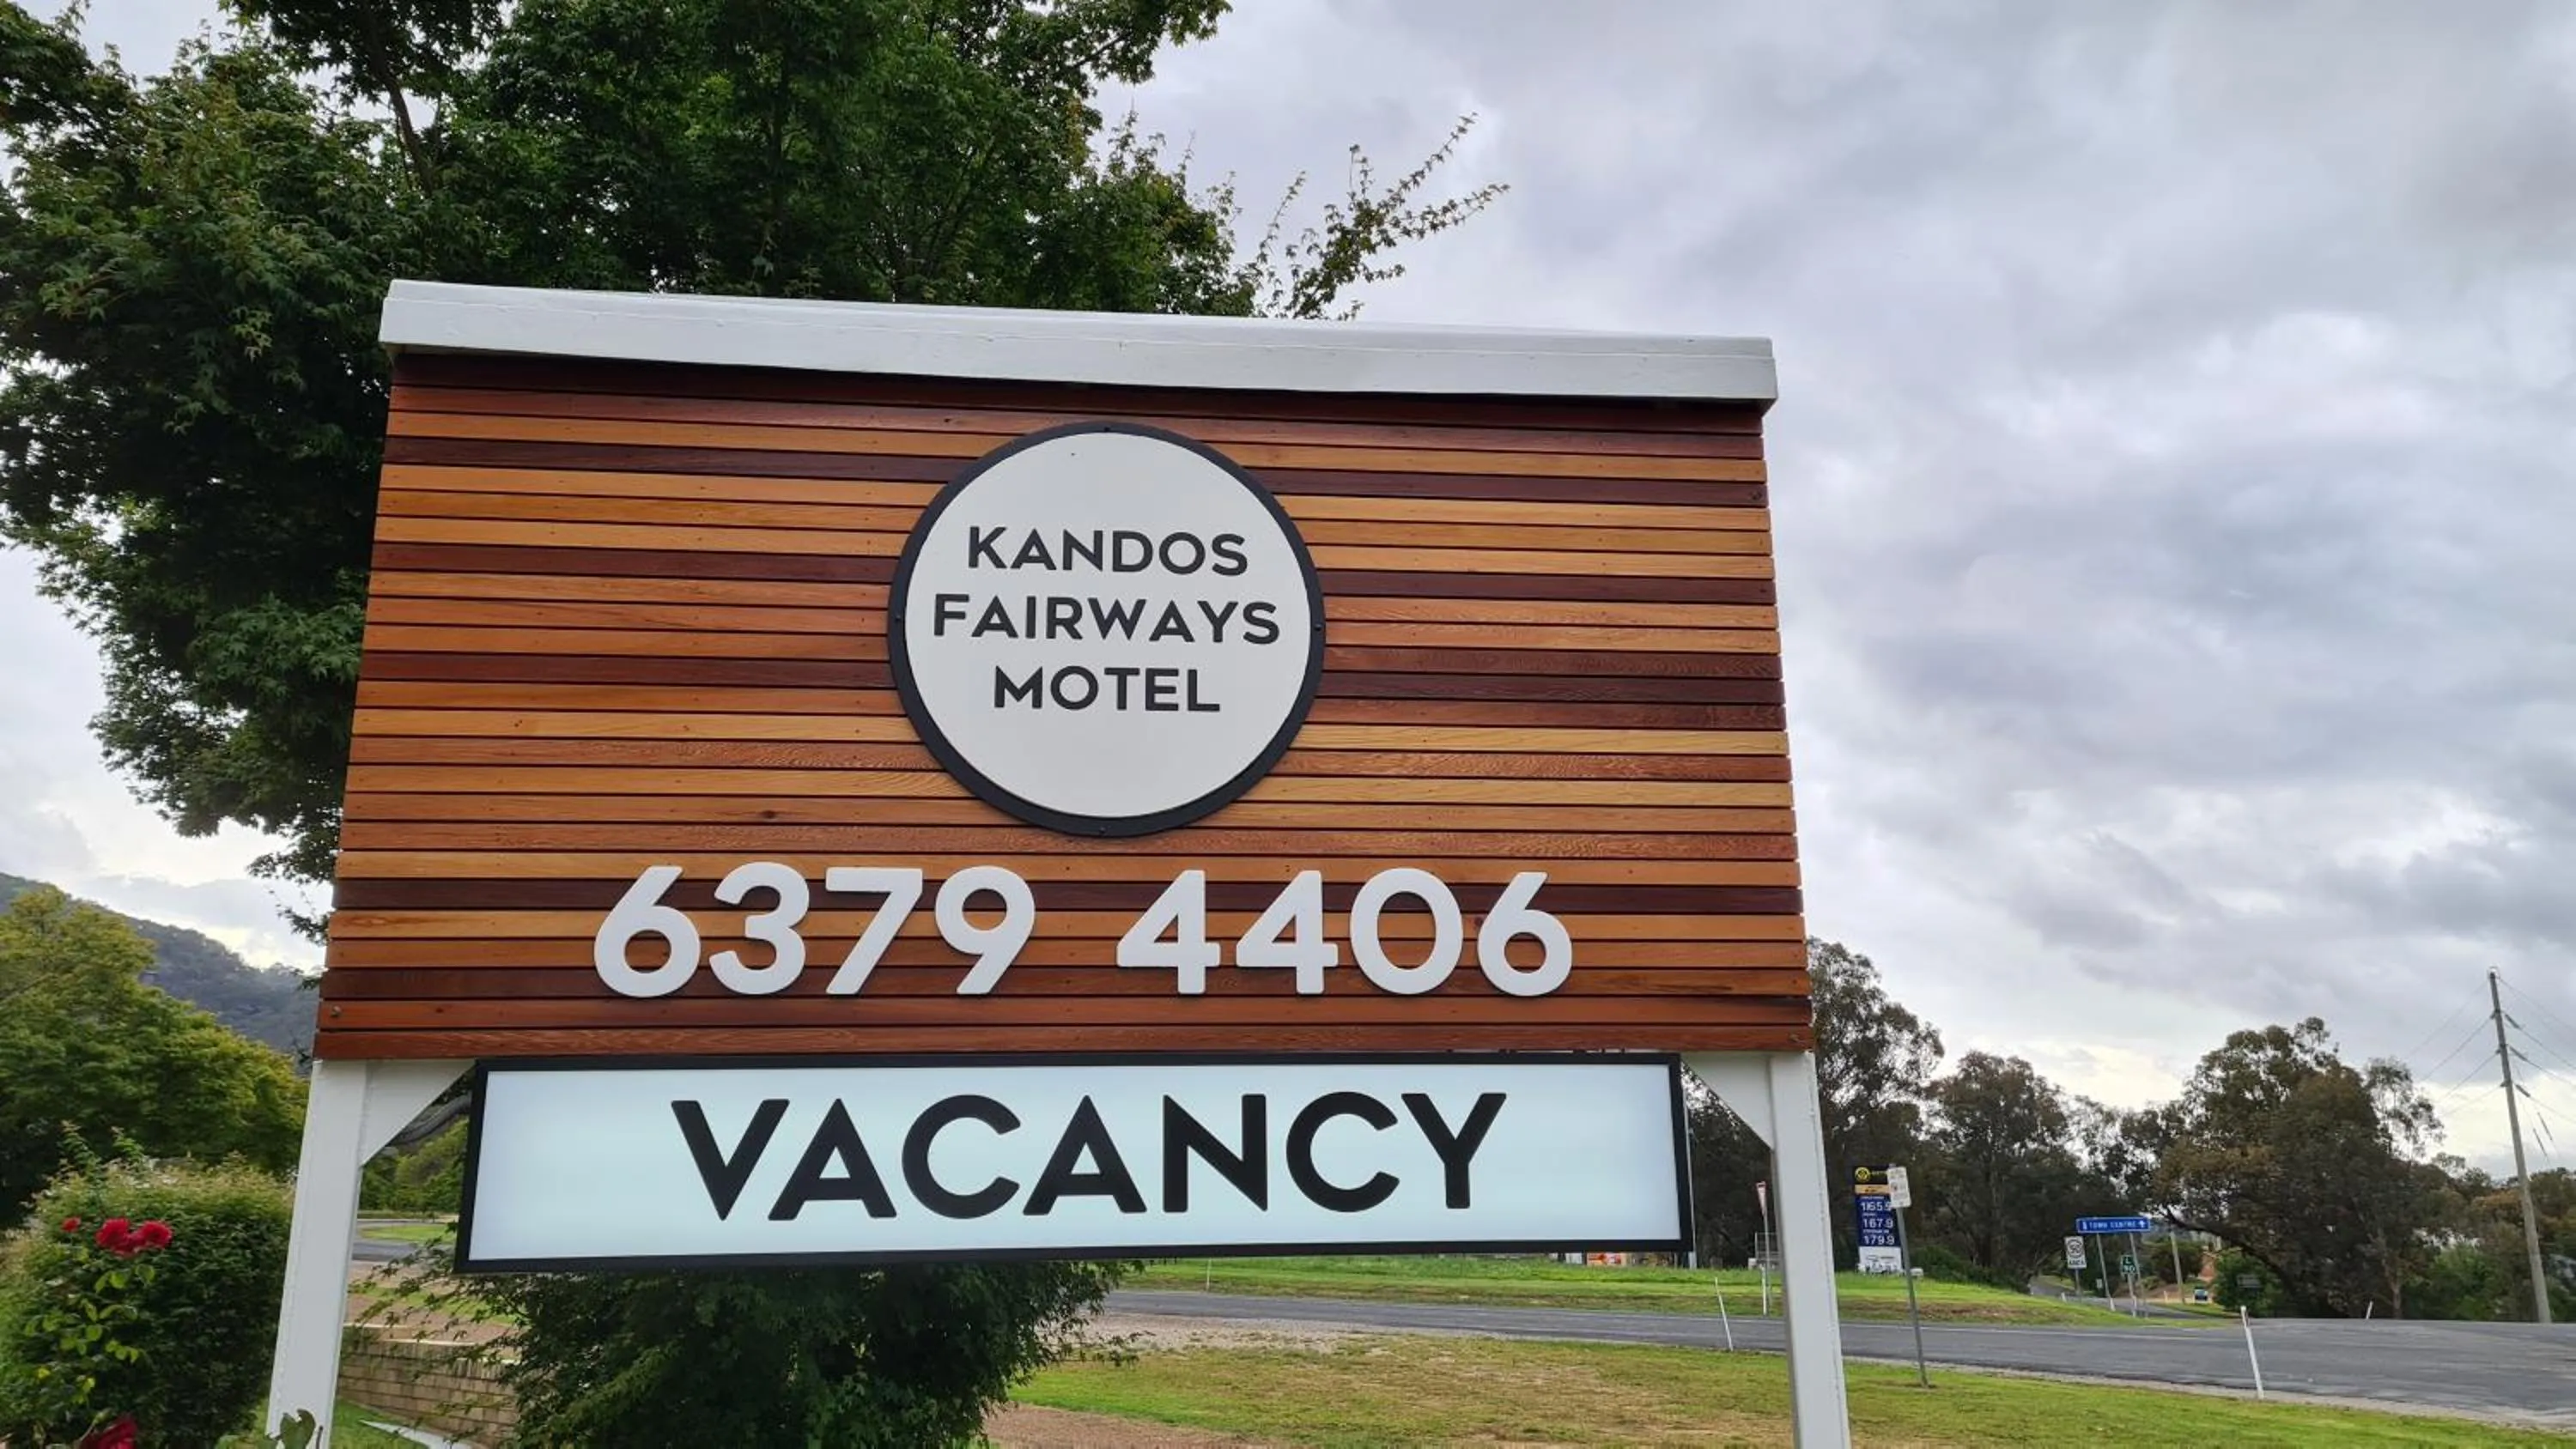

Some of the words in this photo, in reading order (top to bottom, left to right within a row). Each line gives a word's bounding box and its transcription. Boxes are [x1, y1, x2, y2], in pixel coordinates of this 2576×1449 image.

[968, 526, 1248, 577] KANDOS
[933, 593, 1279, 645] FAIRWAYS
[993, 665, 1220, 712] MOTEL
[592, 862, 1036, 997] 6379
[1116, 867, 1573, 997] 4406
[671, 1091, 1507, 1222] VACANCY
